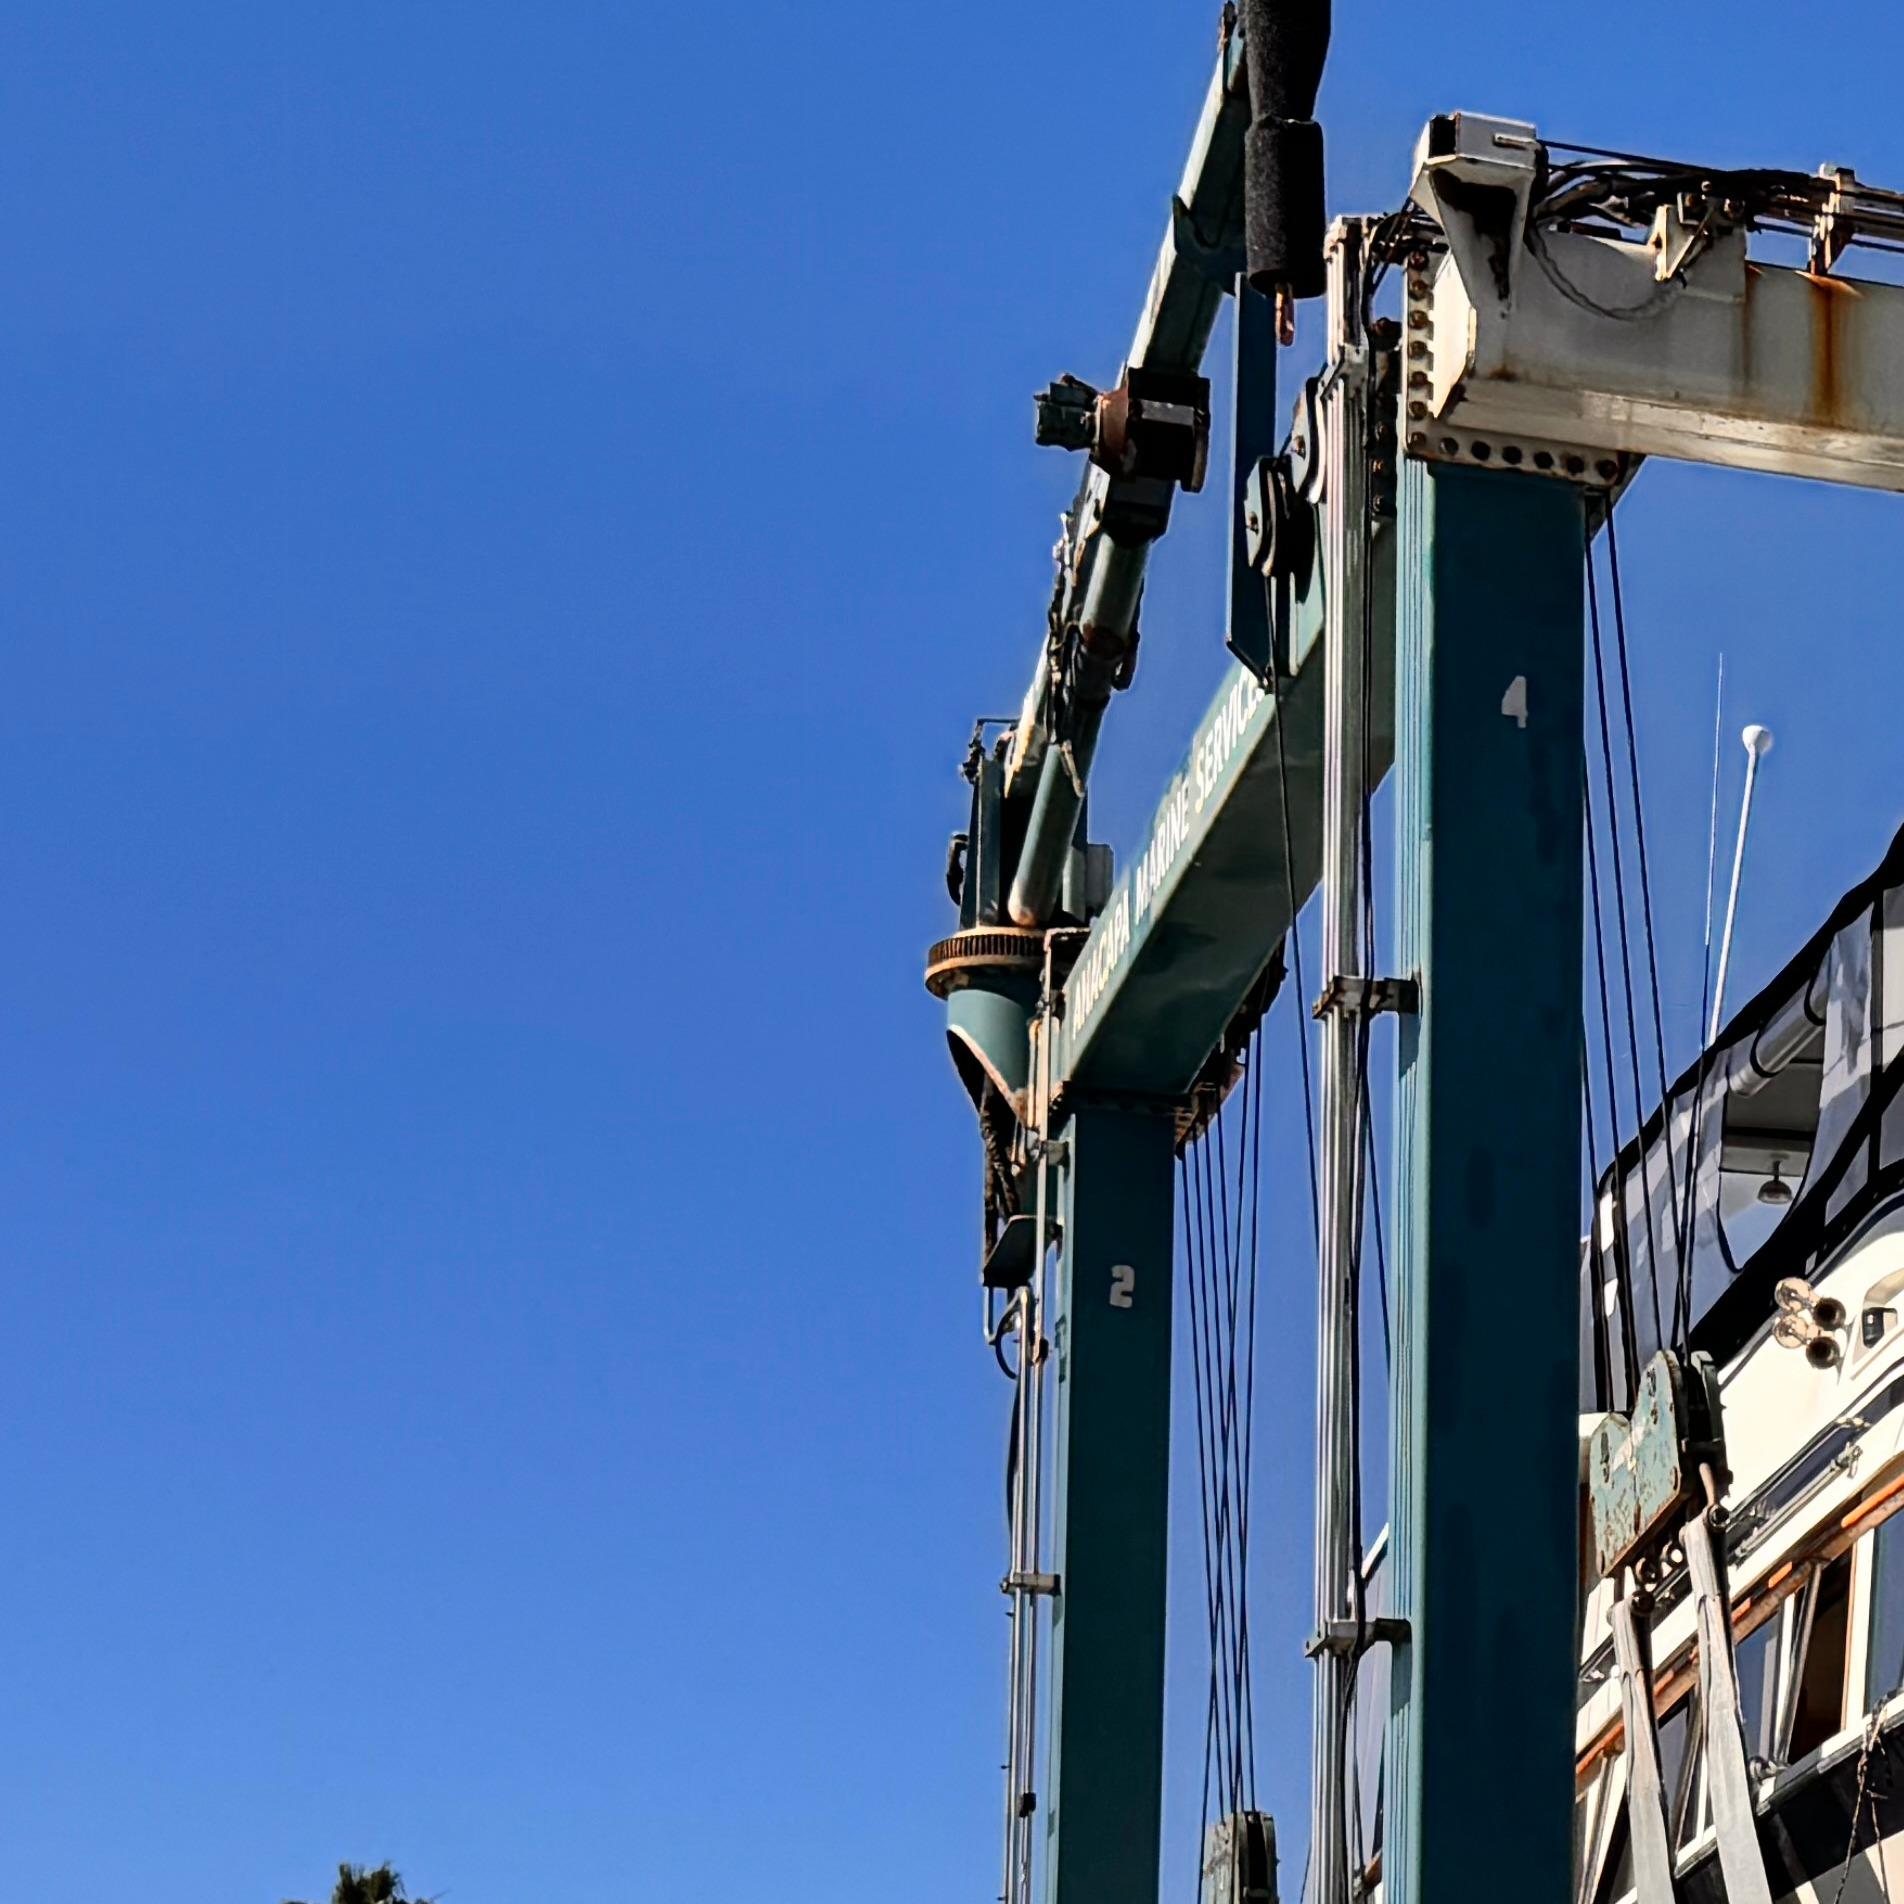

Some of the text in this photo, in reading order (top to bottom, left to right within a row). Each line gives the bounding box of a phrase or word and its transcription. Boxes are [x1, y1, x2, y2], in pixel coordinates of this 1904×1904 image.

[1501, 675, 1528, 728] 4
[1135, 777, 1190, 926] MARINE
[1109, 1264, 1136, 1309] 2
